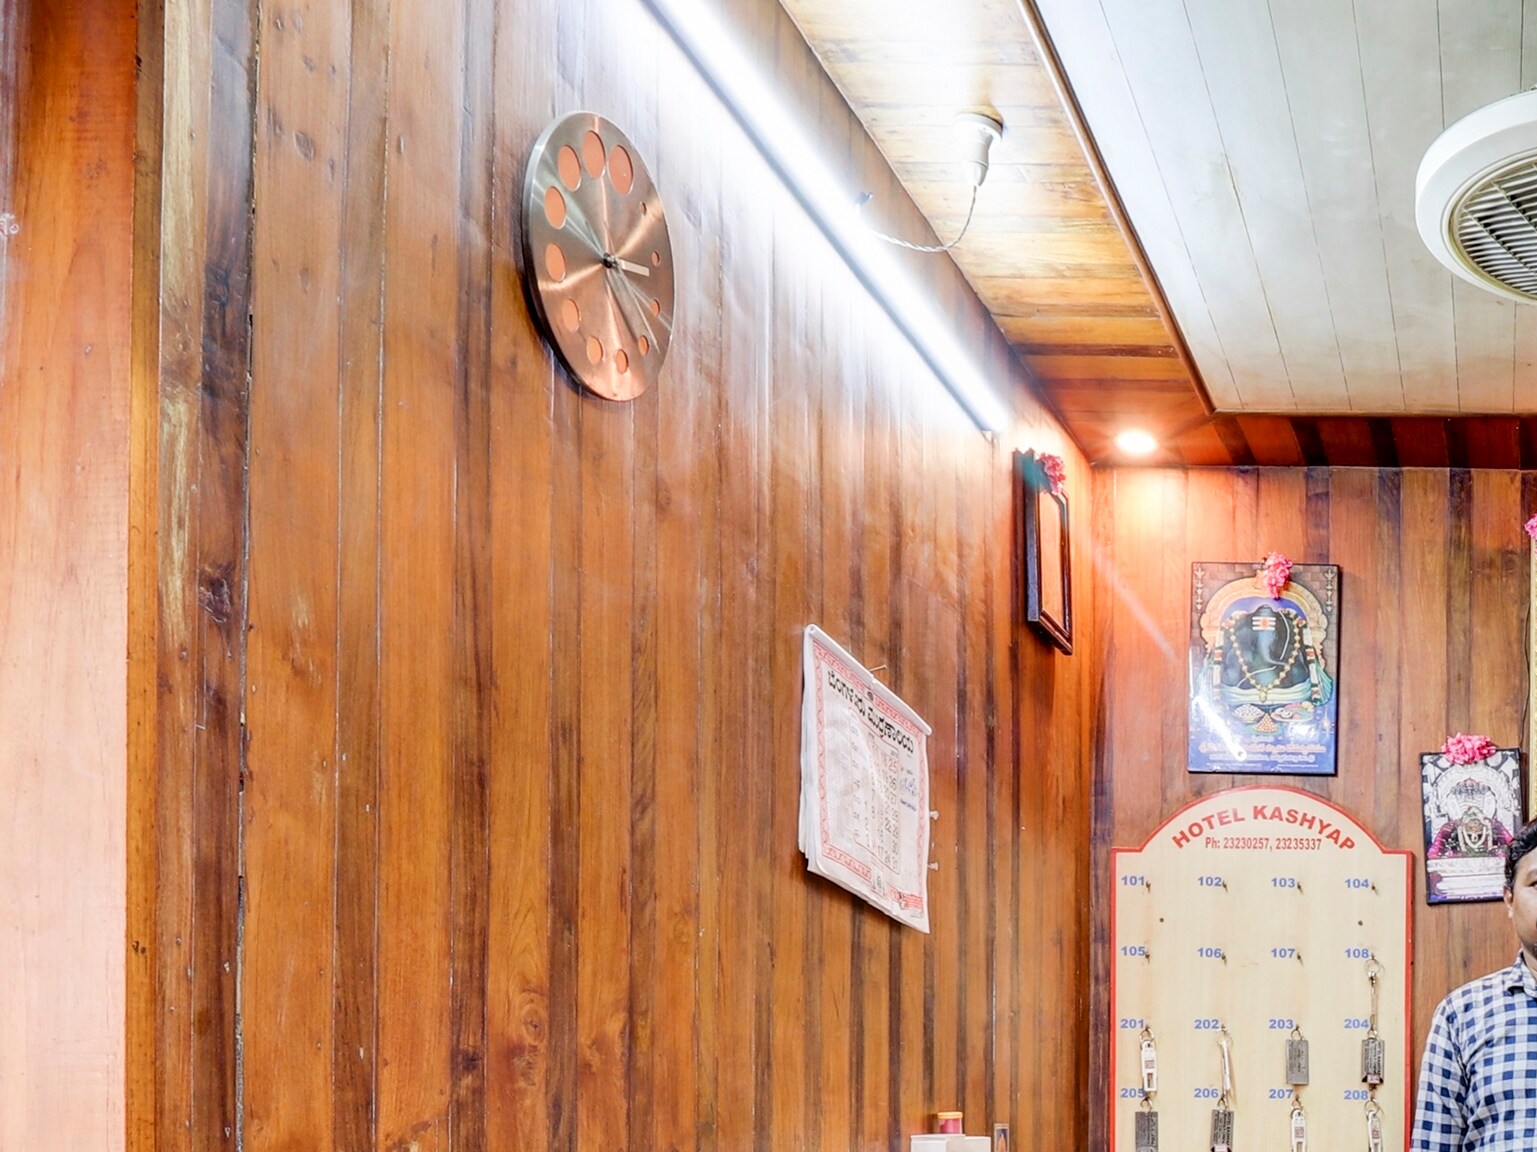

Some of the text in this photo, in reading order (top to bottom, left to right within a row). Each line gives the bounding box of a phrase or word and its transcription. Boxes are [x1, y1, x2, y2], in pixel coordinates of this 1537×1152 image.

[1171, 805, 1356, 852] HOTEL KASHYAP
[1205, 837, 1322, 851] Ph: 23230257, 23235337
[1121, 876, 1146, 887] 101
[1197, 876, 1222, 887] 102
[1271, 877, 1296, 888] 103
[1344, 878, 1369, 889] 104
[1121, 946, 1146, 957] 105
[1197, 947, 1222, 958] 106
[1271, 948, 1295, 959] 107
[1344, 948, 1369, 959] 108
[1120, 1019, 1145, 1030] 201
[1194, 1019, 1219, 1030] 202
[1268, 1019, 1294, 1030] 203
[1344, 1019, 1369, 1030] 204
[1120, 1087, 1145, 1099] 205
[1194, 1088, 1219, 1099] 206
[1269, 1088, 1294, 1100] 207
[1344, 1089, 1368, 1100] 208
